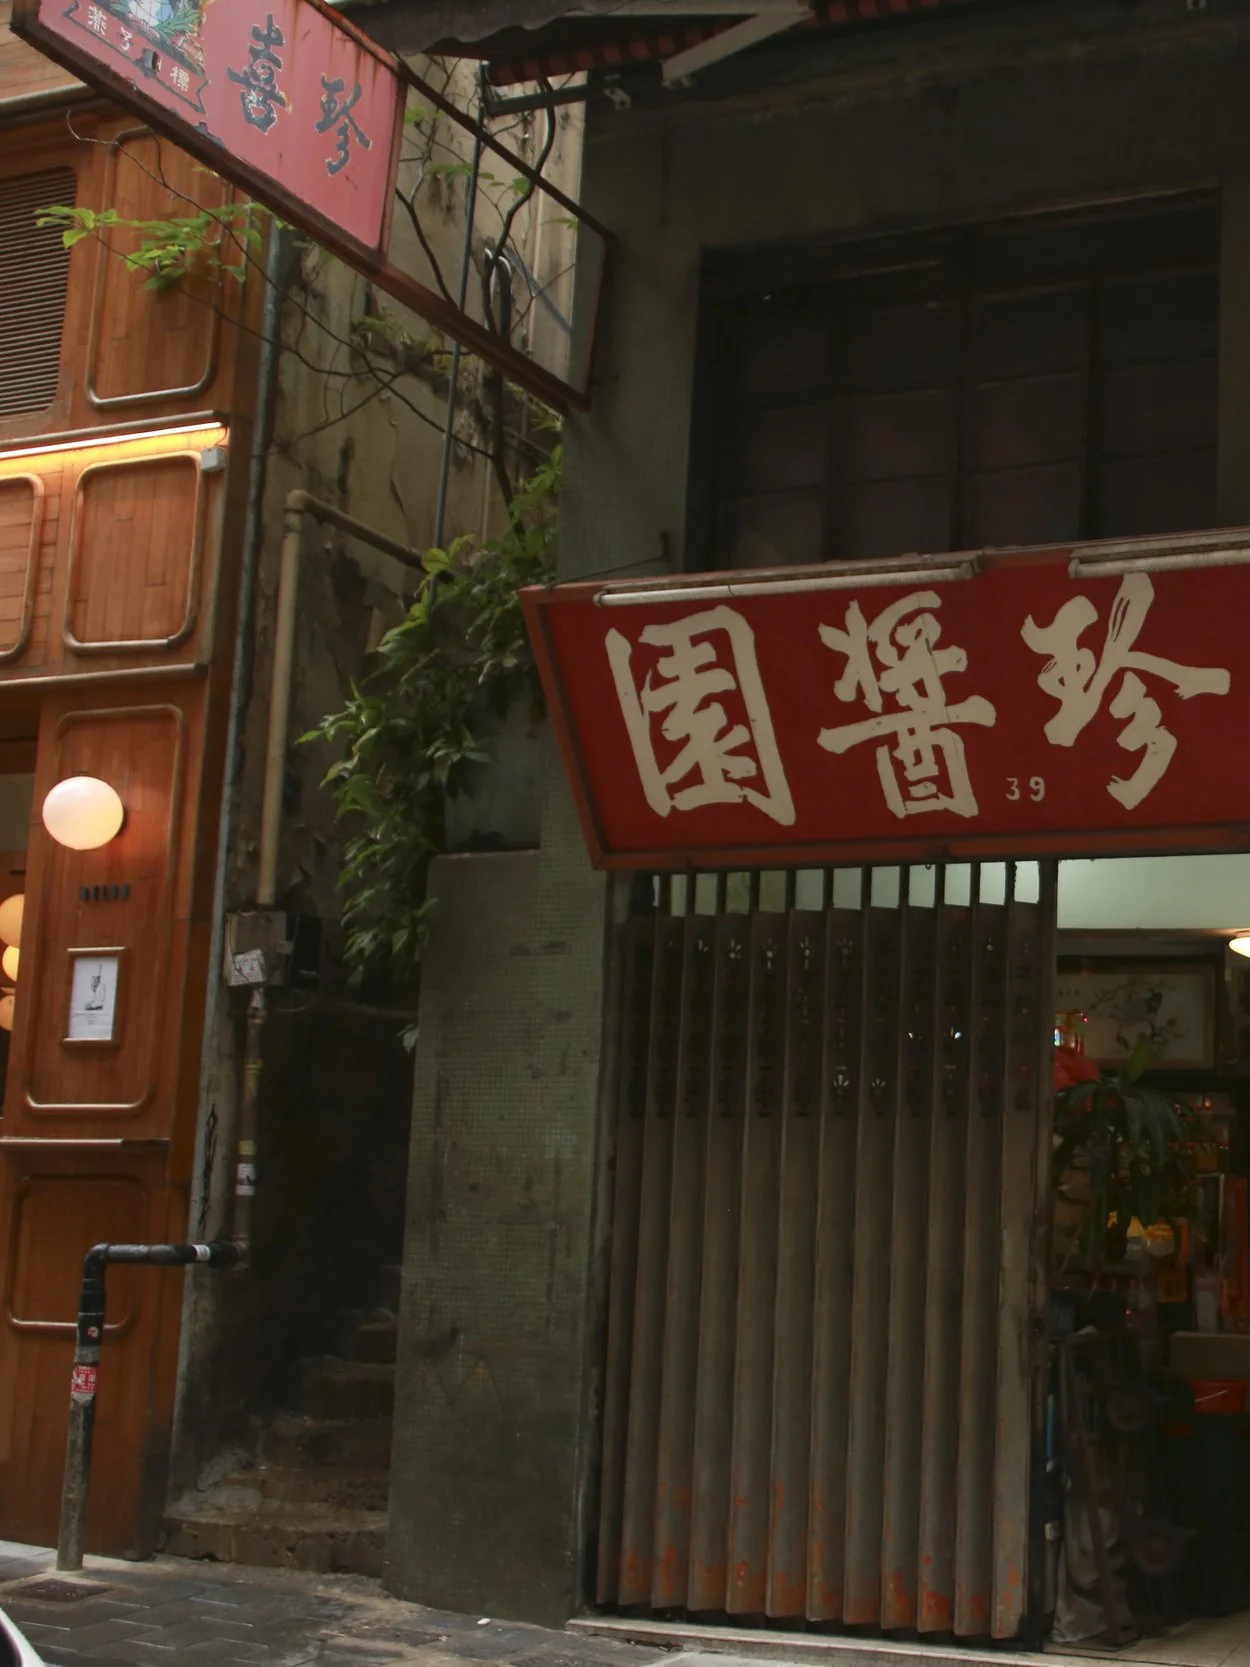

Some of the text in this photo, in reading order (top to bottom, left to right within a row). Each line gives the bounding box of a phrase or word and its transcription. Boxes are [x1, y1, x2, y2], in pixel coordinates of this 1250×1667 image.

[87, 5, 190, 92] 燕子標
[1005, 775, 1046, 802] 39
